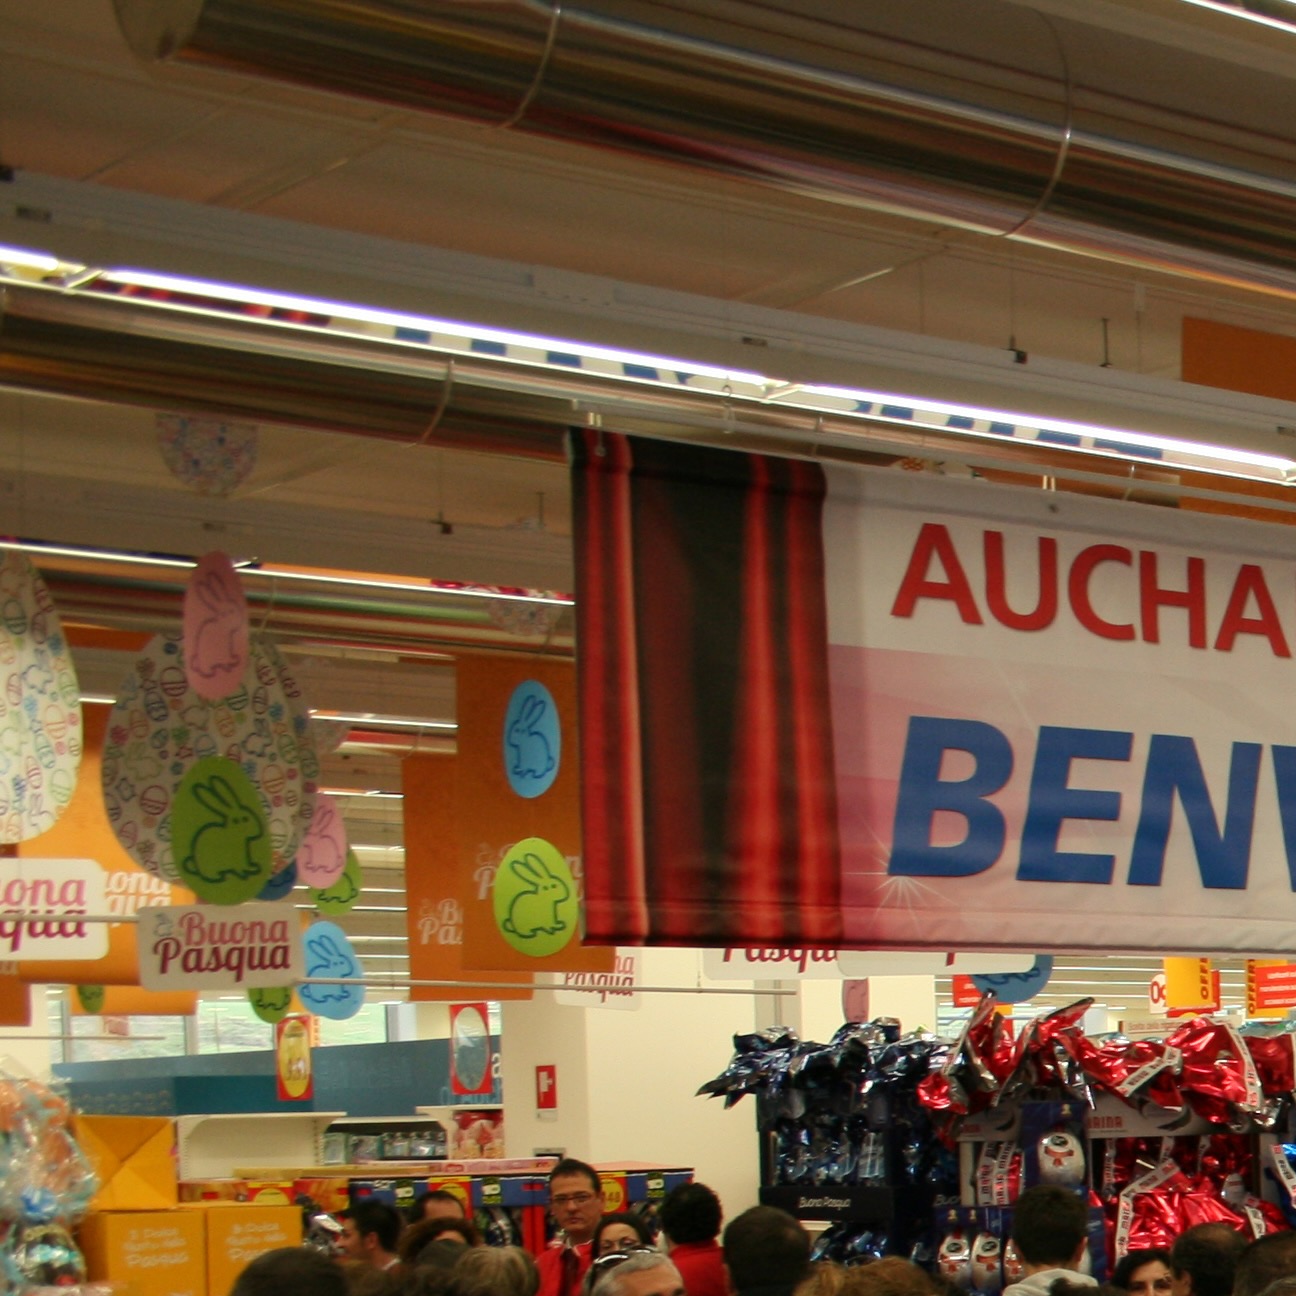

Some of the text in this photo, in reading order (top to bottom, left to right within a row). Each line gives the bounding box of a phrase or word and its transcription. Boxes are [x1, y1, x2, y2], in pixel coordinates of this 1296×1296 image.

[2, 878, 87, 906] ona
[179, 911, 289, 946] Buona
[152, 936, 291, 983] Pasqua
